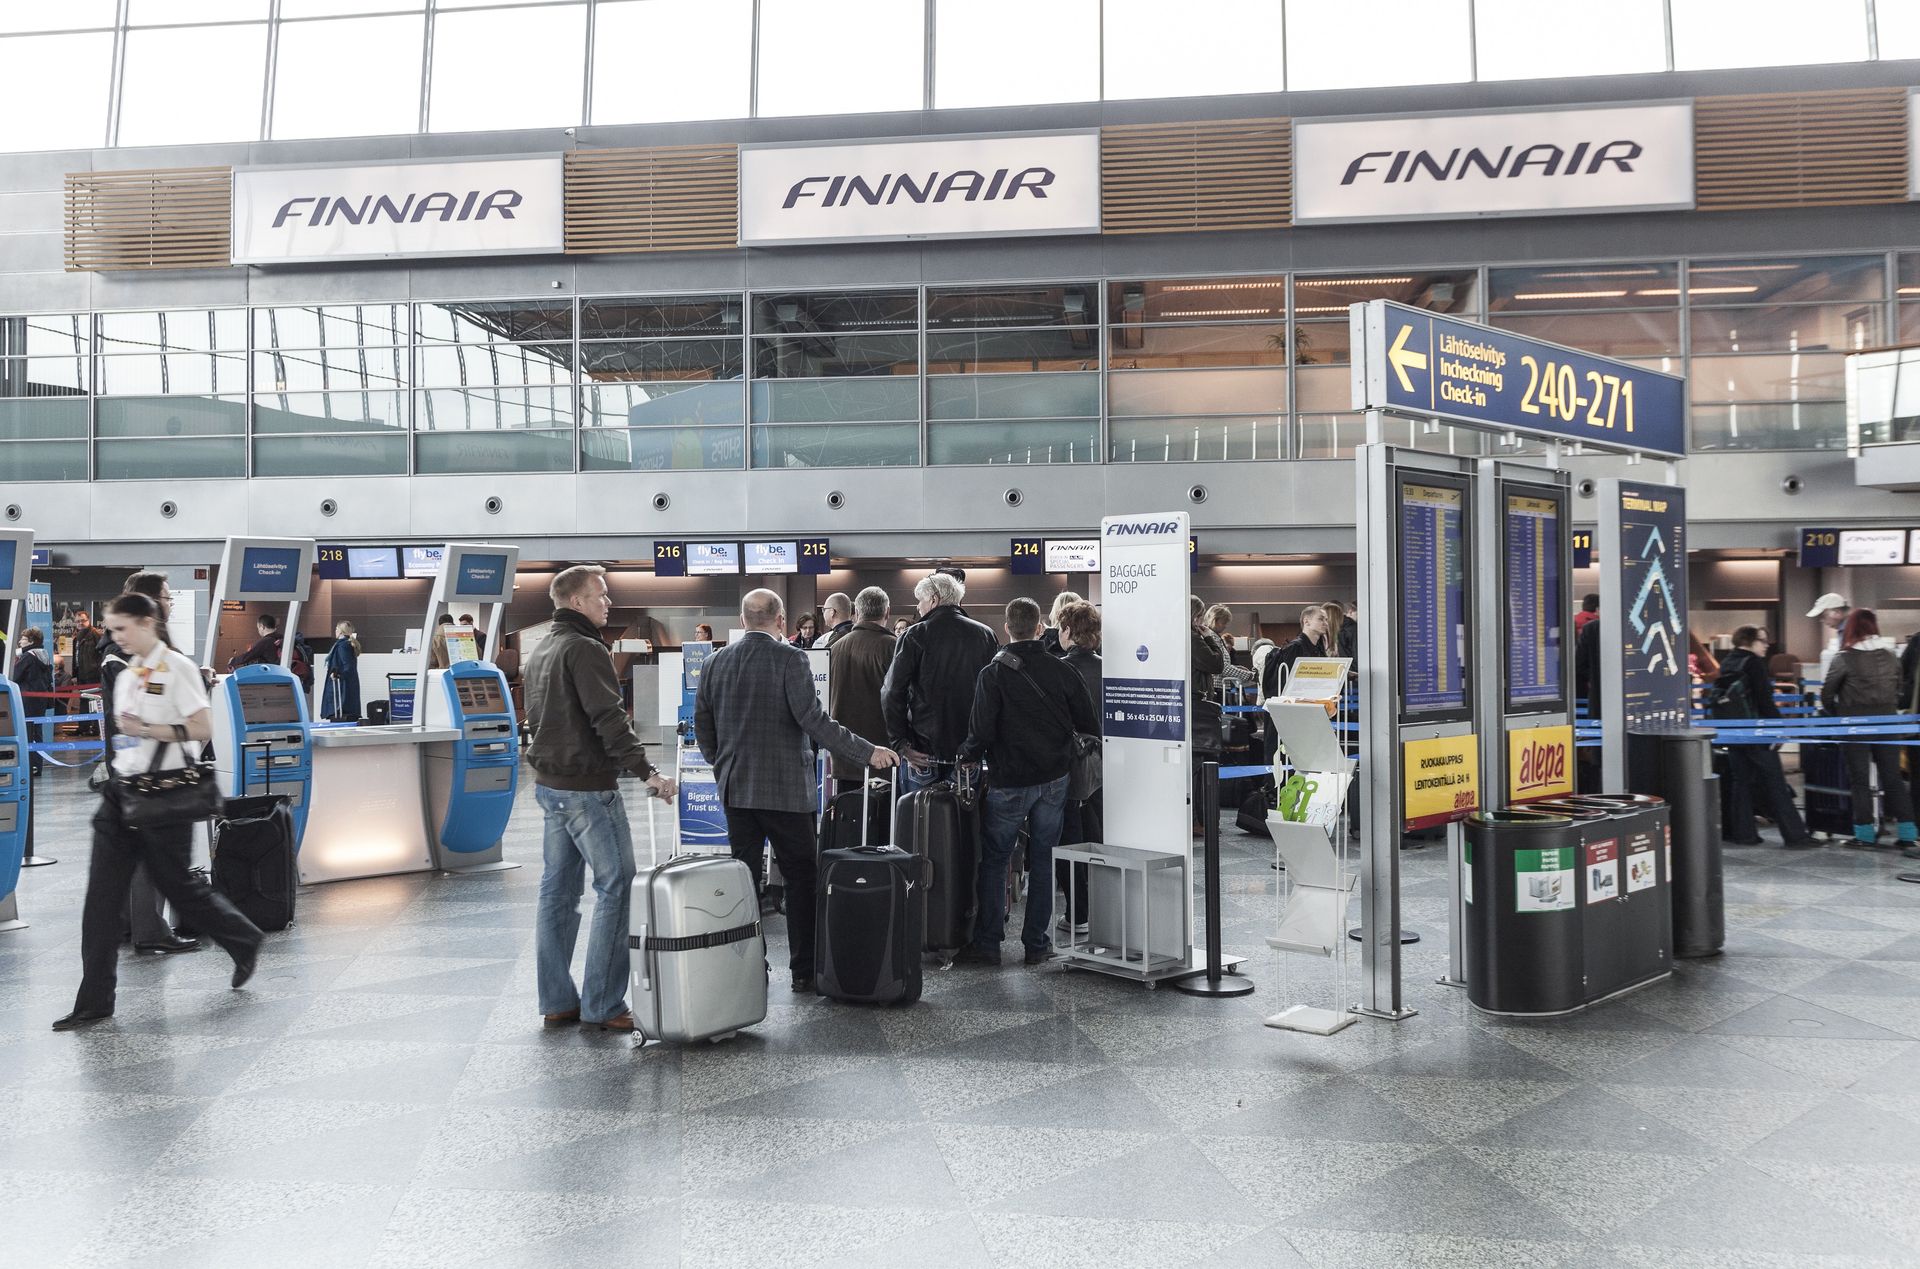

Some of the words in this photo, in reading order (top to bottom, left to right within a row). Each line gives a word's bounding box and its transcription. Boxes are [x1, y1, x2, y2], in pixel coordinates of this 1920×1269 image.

[1340, 140, 1643, 186] FINNAIR
[781, 167, 1056, 209] FINNAIR
[271, 189, 523, 228] FINNAIR
[1440, 333, 1506, 369] Lähtöselvitys
[1440, 358, 1503, 392] Incheckning
[1440, 380, 1487, 407] Check-in
[1520, 356, 1634, 432] 240-271
[1106, 522, 1178, 535] FINNAIR
[1572, 535, 1590, 548] 11
[1806, 533, 1836, 546] 210
[321, 550, 343, 561] 218
[657, 546, 680, 558] 216
[803, 543, 827, 556] 215
[1014, 544, 1038, 555] 214
[1110, 564, 1157, 578] BAGGAGE
[1110, 581, 1138, 594] DROP
[1420, 754, 1464, 768] RUOKAKAUPPASI
[1520, 740, 1565, 787] alepa
[1415, 774, 1456, 790] LENTOKENTÄLLÄ
[1457, 776, 1464, 785] 24
[1465, 774, 1470, 783] H
[688, 792, 714, 802] Bigger
[1454, 790, 1475, 808] alepa
[687, 803, 706, 811] Trust
